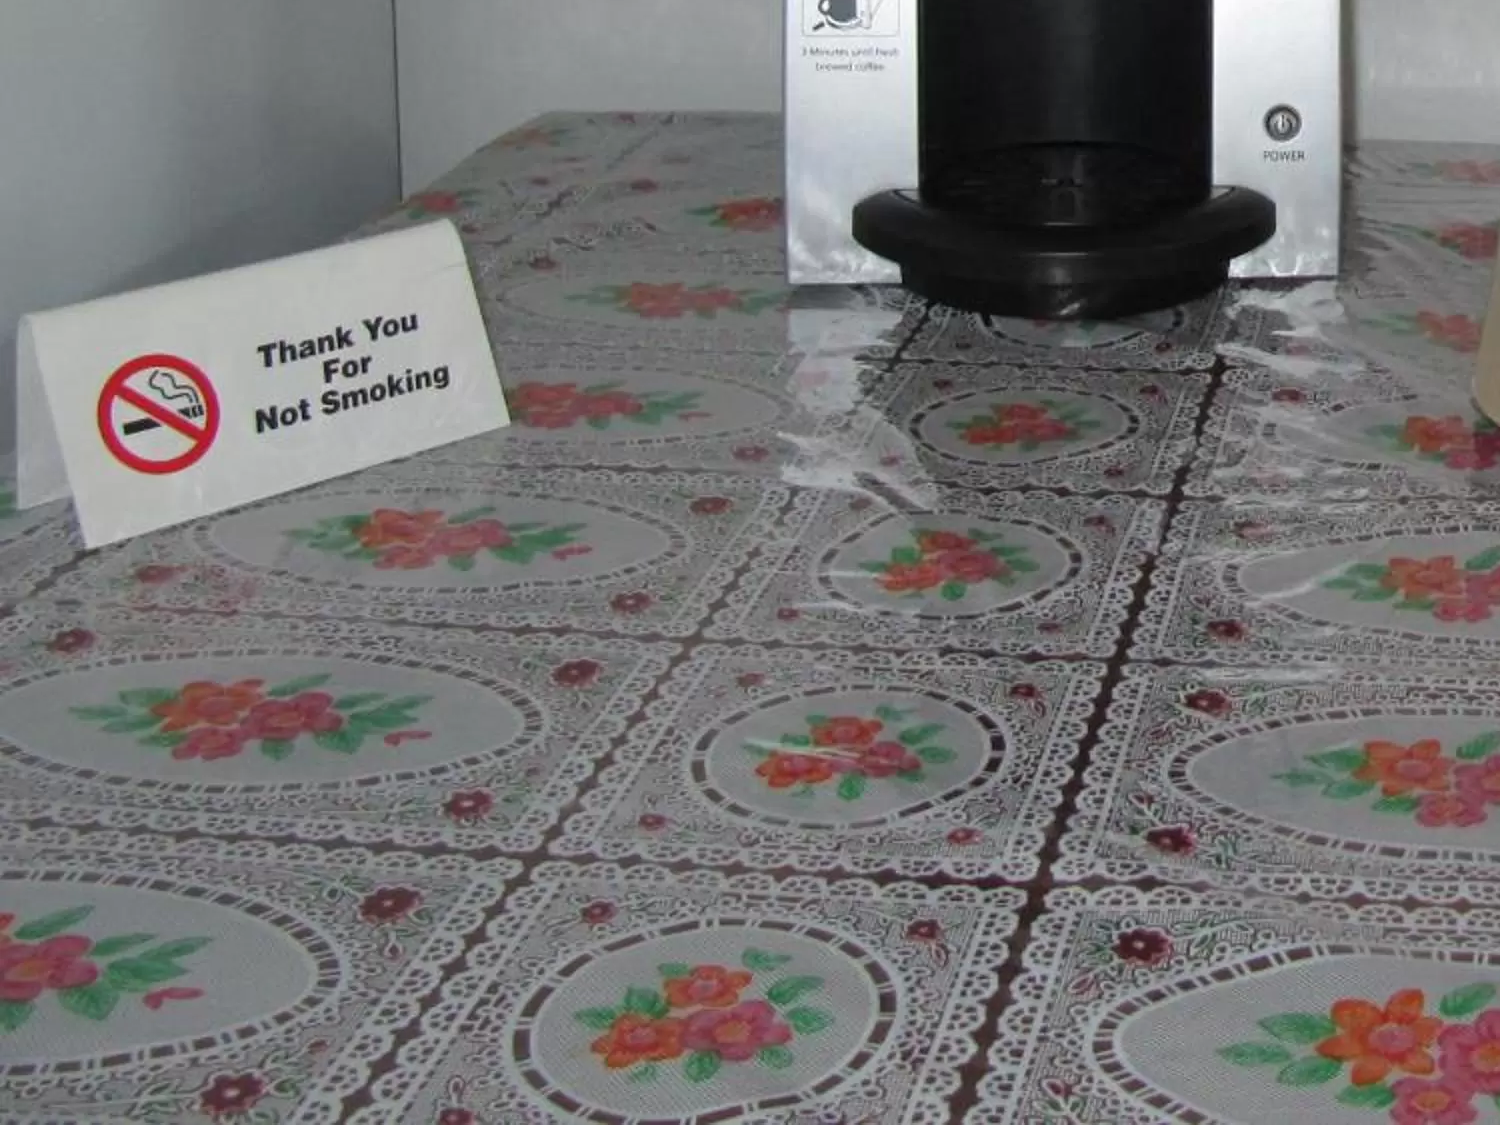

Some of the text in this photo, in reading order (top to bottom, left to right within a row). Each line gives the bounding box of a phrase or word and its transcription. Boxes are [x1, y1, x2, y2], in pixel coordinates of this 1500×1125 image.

[1263, 150, 1305, 163] POWER
[256, 313, 419, 368] Thank You
[322, 355, 373, 383] For
[255, 365, 451, 434] Not Smoking
